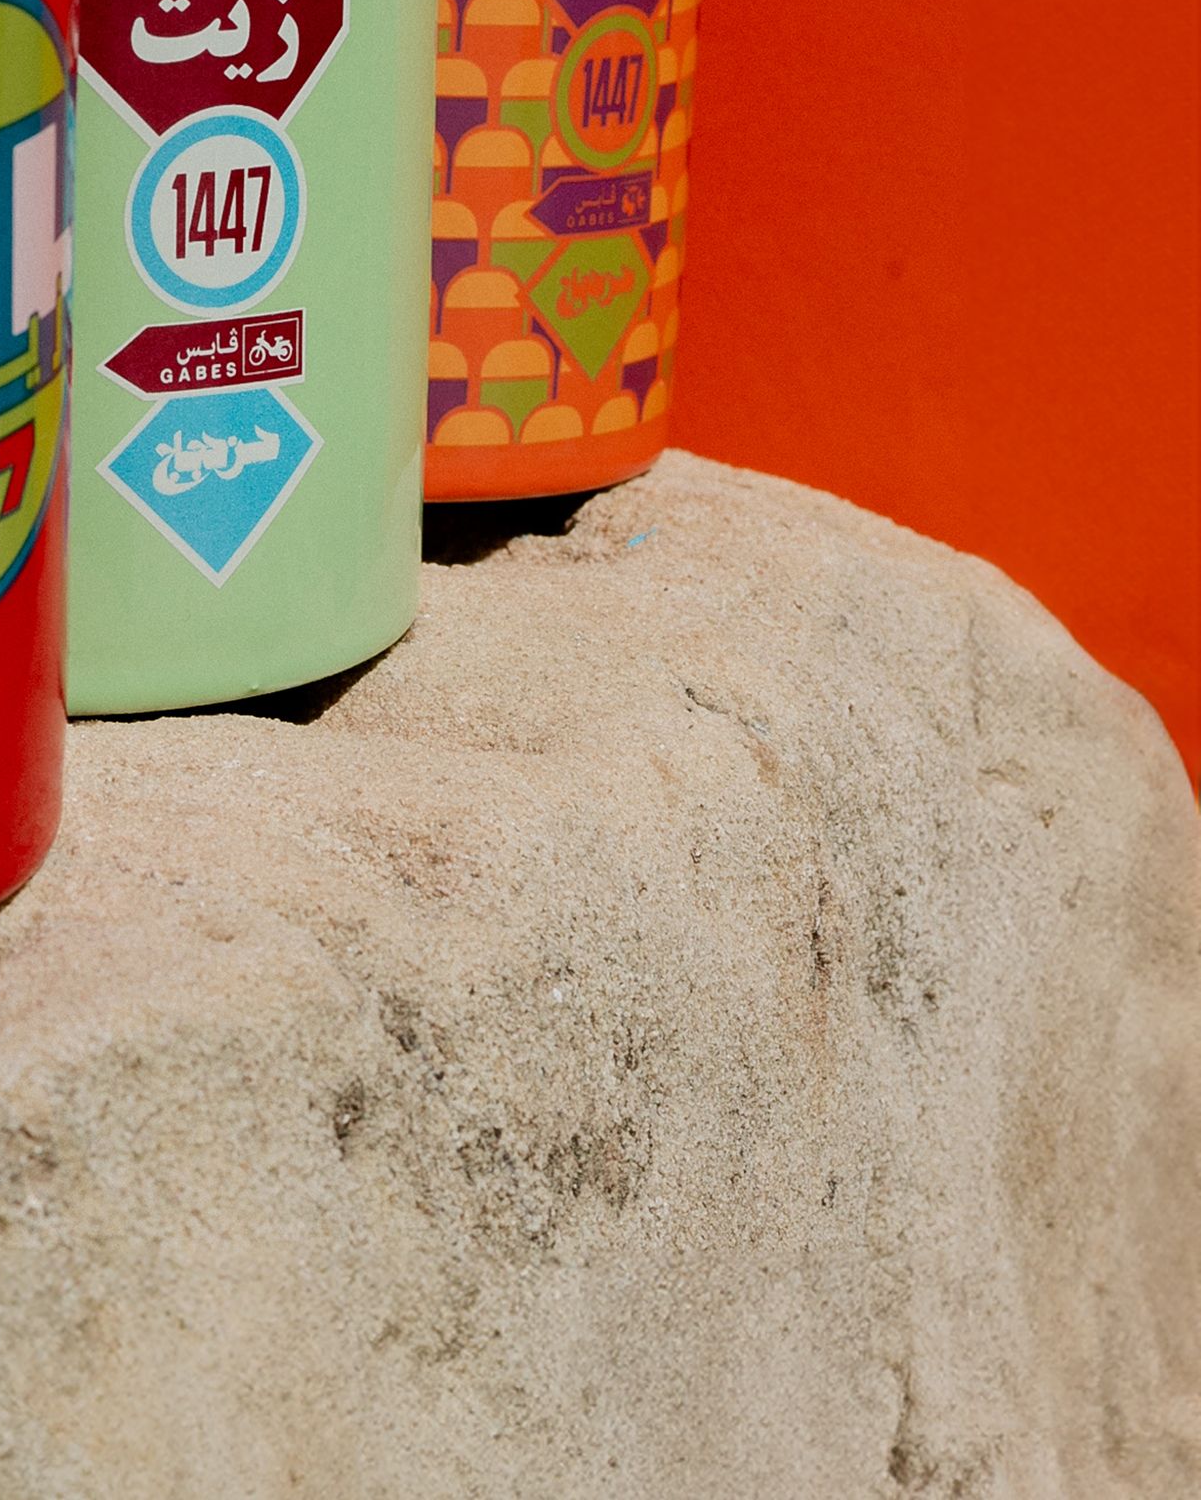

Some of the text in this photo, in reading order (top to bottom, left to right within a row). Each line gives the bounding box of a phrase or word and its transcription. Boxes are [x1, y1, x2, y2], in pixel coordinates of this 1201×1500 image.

[582, 54, 644, 129] 1447
[171, 165, 272, 260] 1447
[160, 362, 237, 384] GABES
